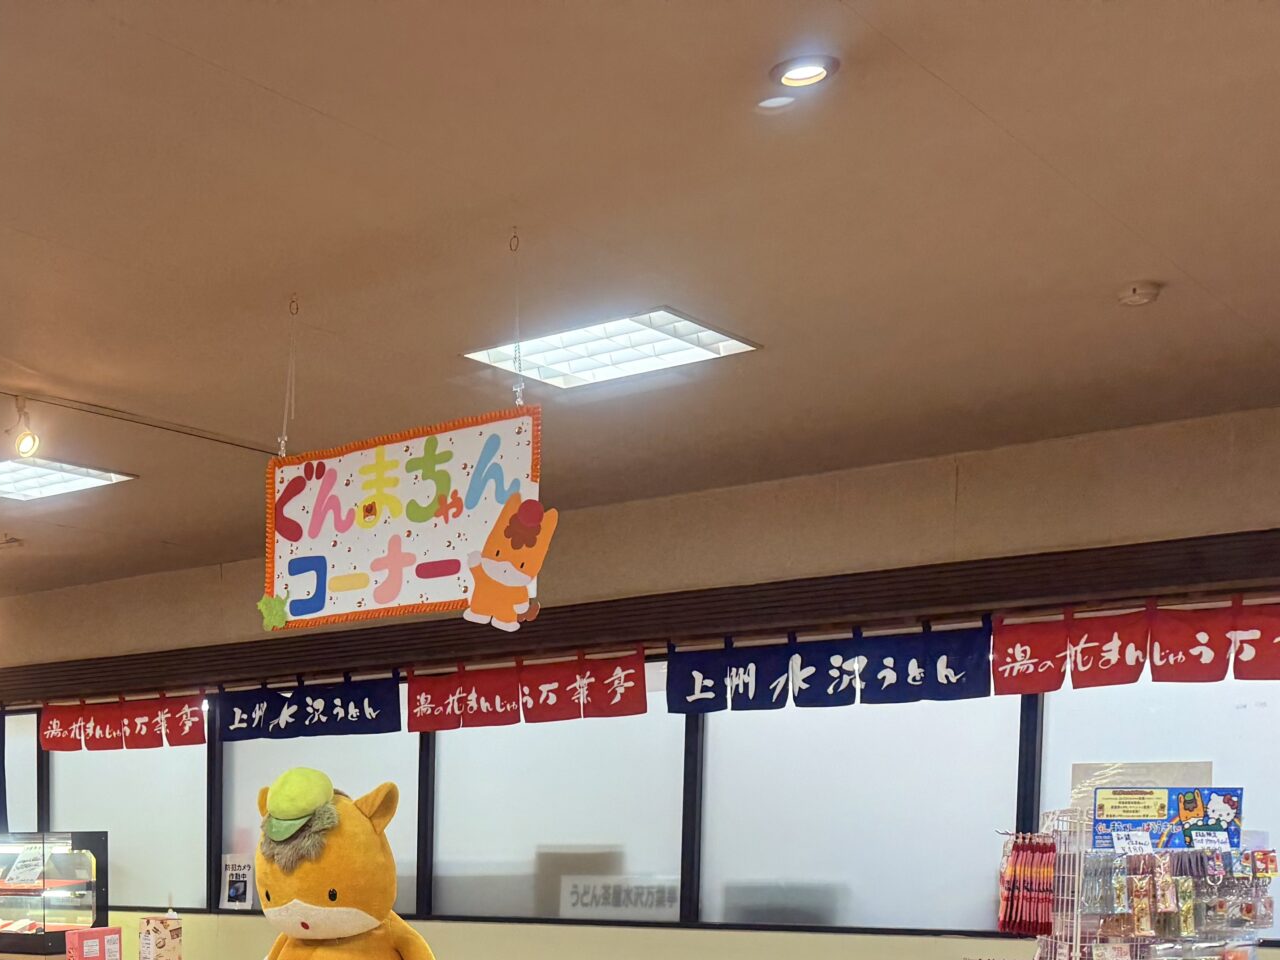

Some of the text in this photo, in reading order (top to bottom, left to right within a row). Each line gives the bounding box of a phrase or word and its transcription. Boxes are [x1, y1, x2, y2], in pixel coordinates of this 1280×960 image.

[275, 433, 521, 543] ぐんまちゃん
[287, 534, 462, 616] コーナー
[998, 629, 1280, 678] 湯の花まんじゅう万
